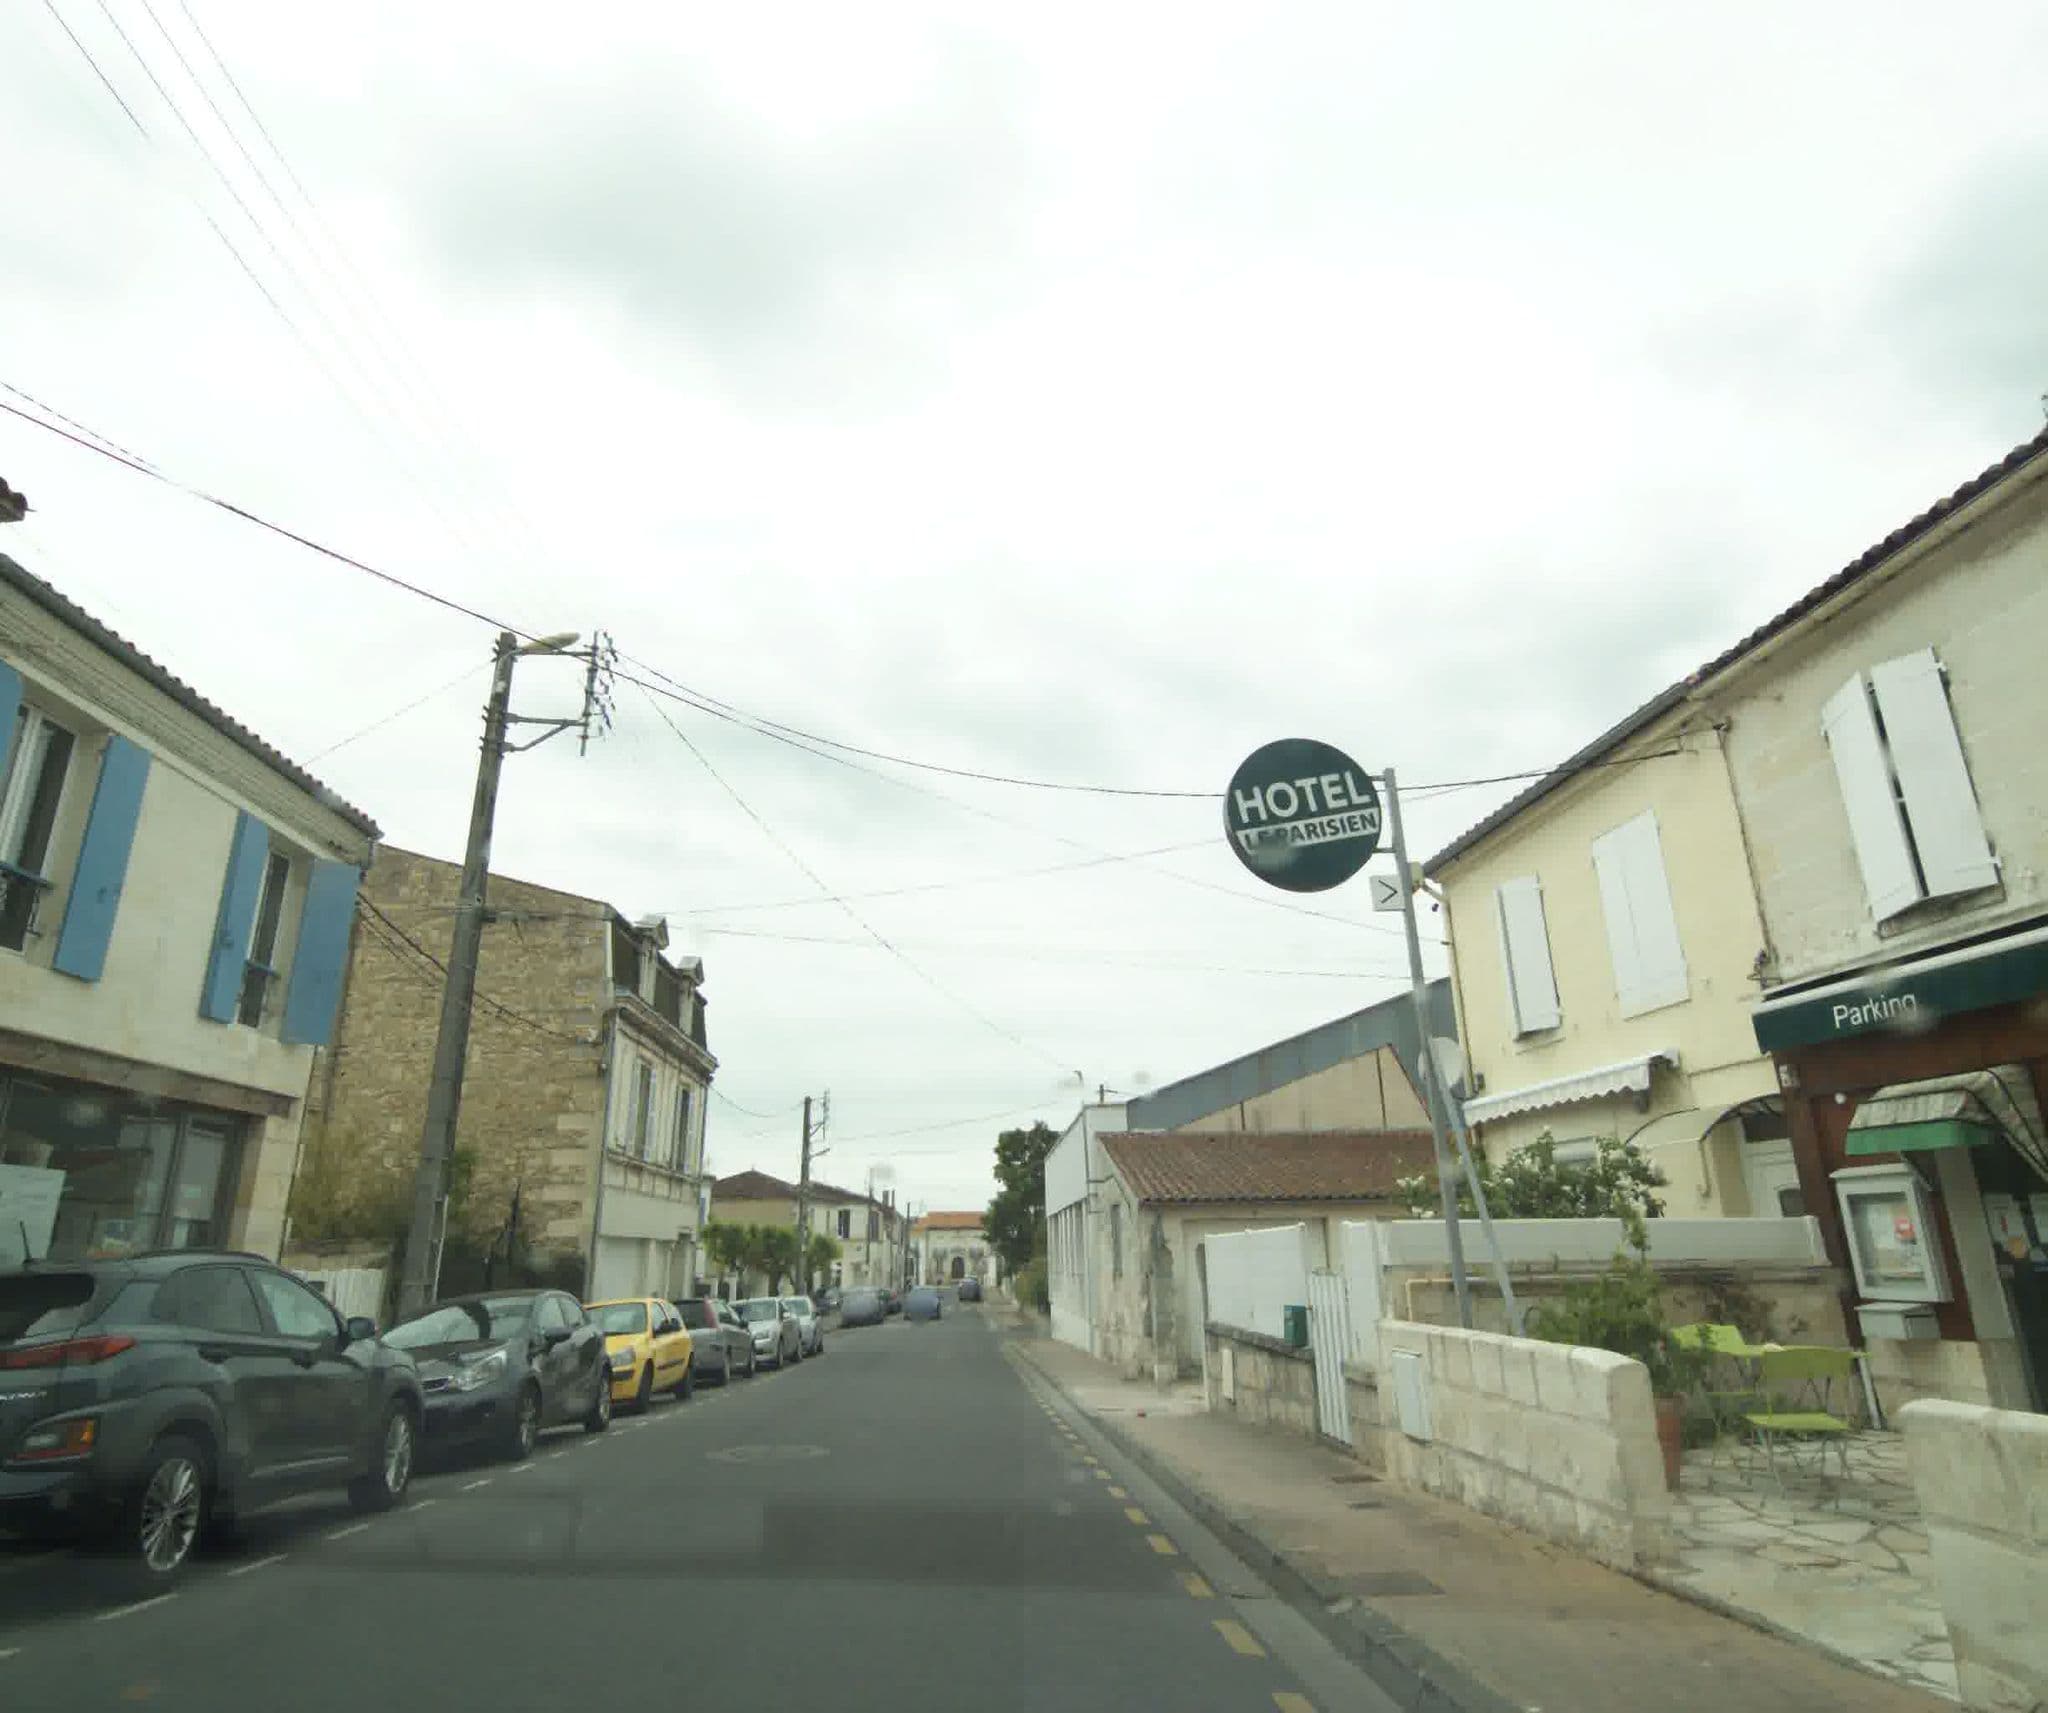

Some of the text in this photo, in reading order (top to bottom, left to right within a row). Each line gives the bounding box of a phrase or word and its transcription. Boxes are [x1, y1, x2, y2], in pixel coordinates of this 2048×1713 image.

[1235, 771, 1371, 823] HOTEL
[1276, 812, 1377, 845] PARISIEN
[1833, 993, 1917, 1028] Parking
